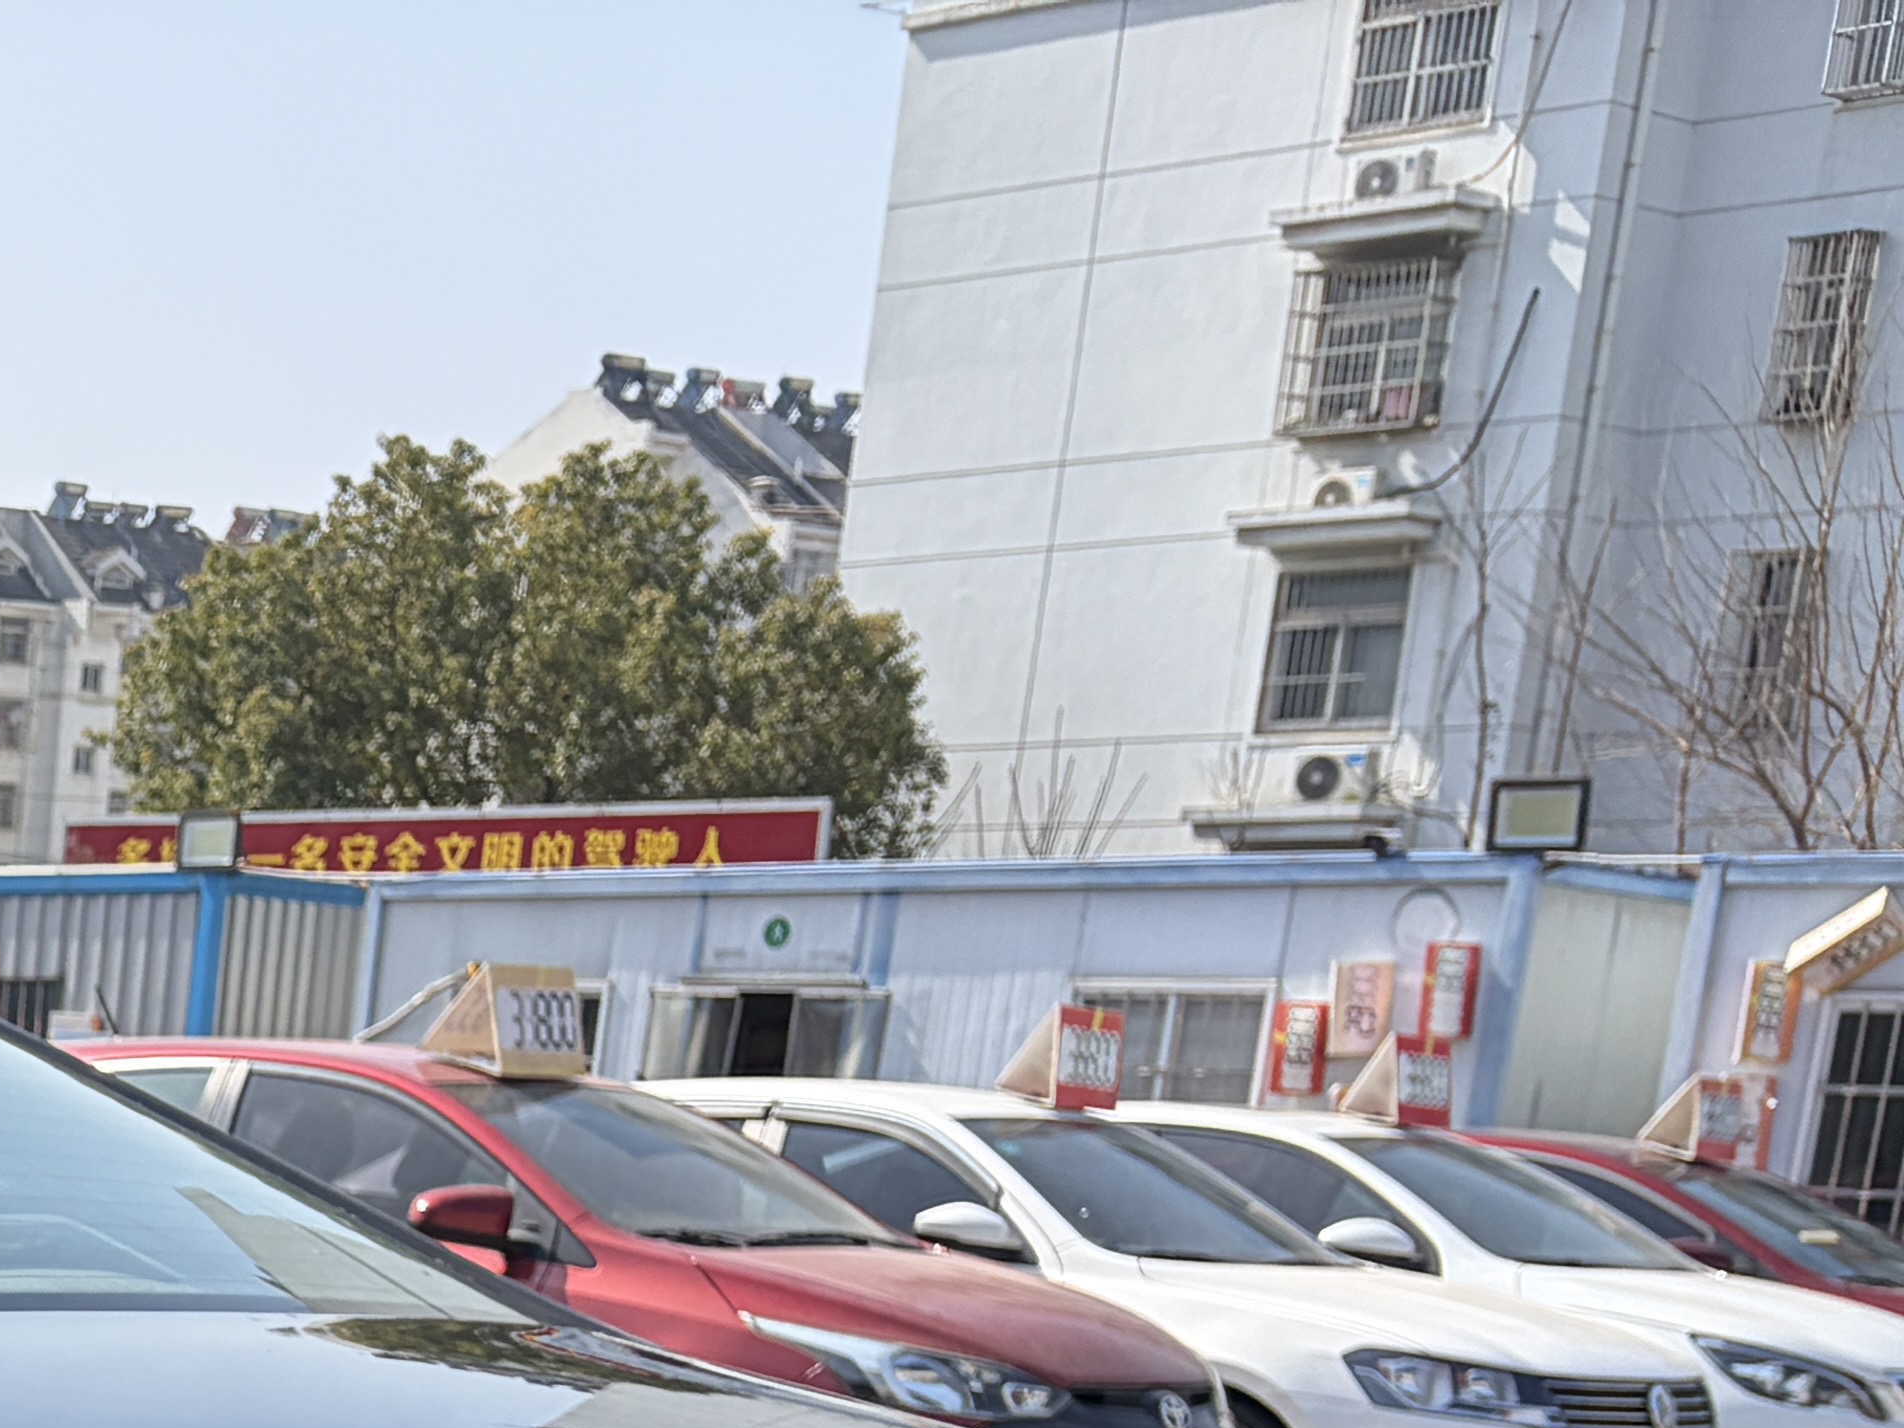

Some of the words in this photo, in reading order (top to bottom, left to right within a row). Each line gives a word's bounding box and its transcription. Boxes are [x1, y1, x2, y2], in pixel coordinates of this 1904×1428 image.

[115, 826, 724, 872] 多一名安全文明的驾驶人
